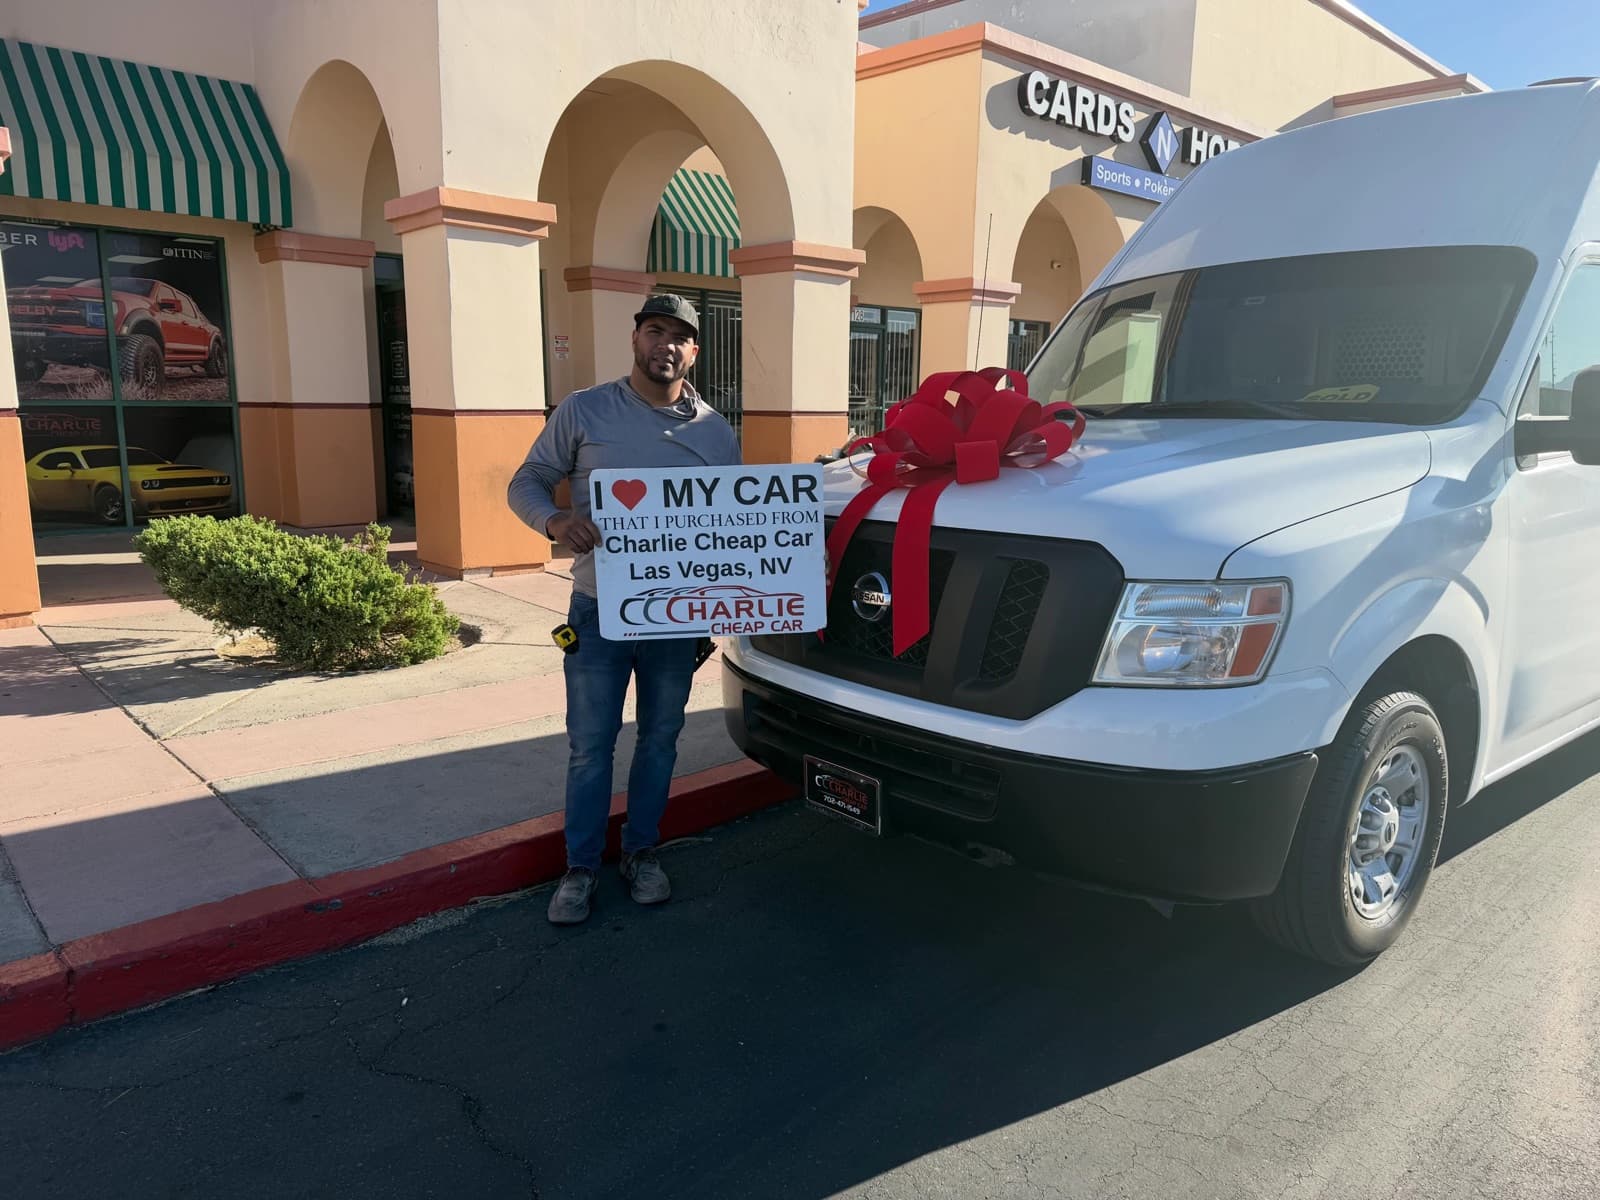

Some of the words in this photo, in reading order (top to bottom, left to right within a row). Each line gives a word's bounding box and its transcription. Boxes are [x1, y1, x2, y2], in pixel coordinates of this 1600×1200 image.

[1025, 70, 1136, 143] CARDS
[1157, 127, 1172, 160] N
[1096, 164, 1132, 188] Sports
[594, 481, 603, 510] I
[662, 477, 721, 508] MY
[733, 474, 820, 505] CAR
[599, 516, 649, 531] THAT
[655, 515, 661, 529] I
[665, 512, 767, 529] PURCHASED
[771, 510, 820, 526] FROM
[605, 533, 688, 554] Charlie
[694, 531, 768, 553] Cheap
[774, 530, 814, 548] Car
[629, 562, 671, 581] Las
[677, 560, 753, 582] Vegas,
[760, 557, 793, 575] NV
[711, 620, 765, 635] CHEAP
[770, 619, 804, 632] CAR
